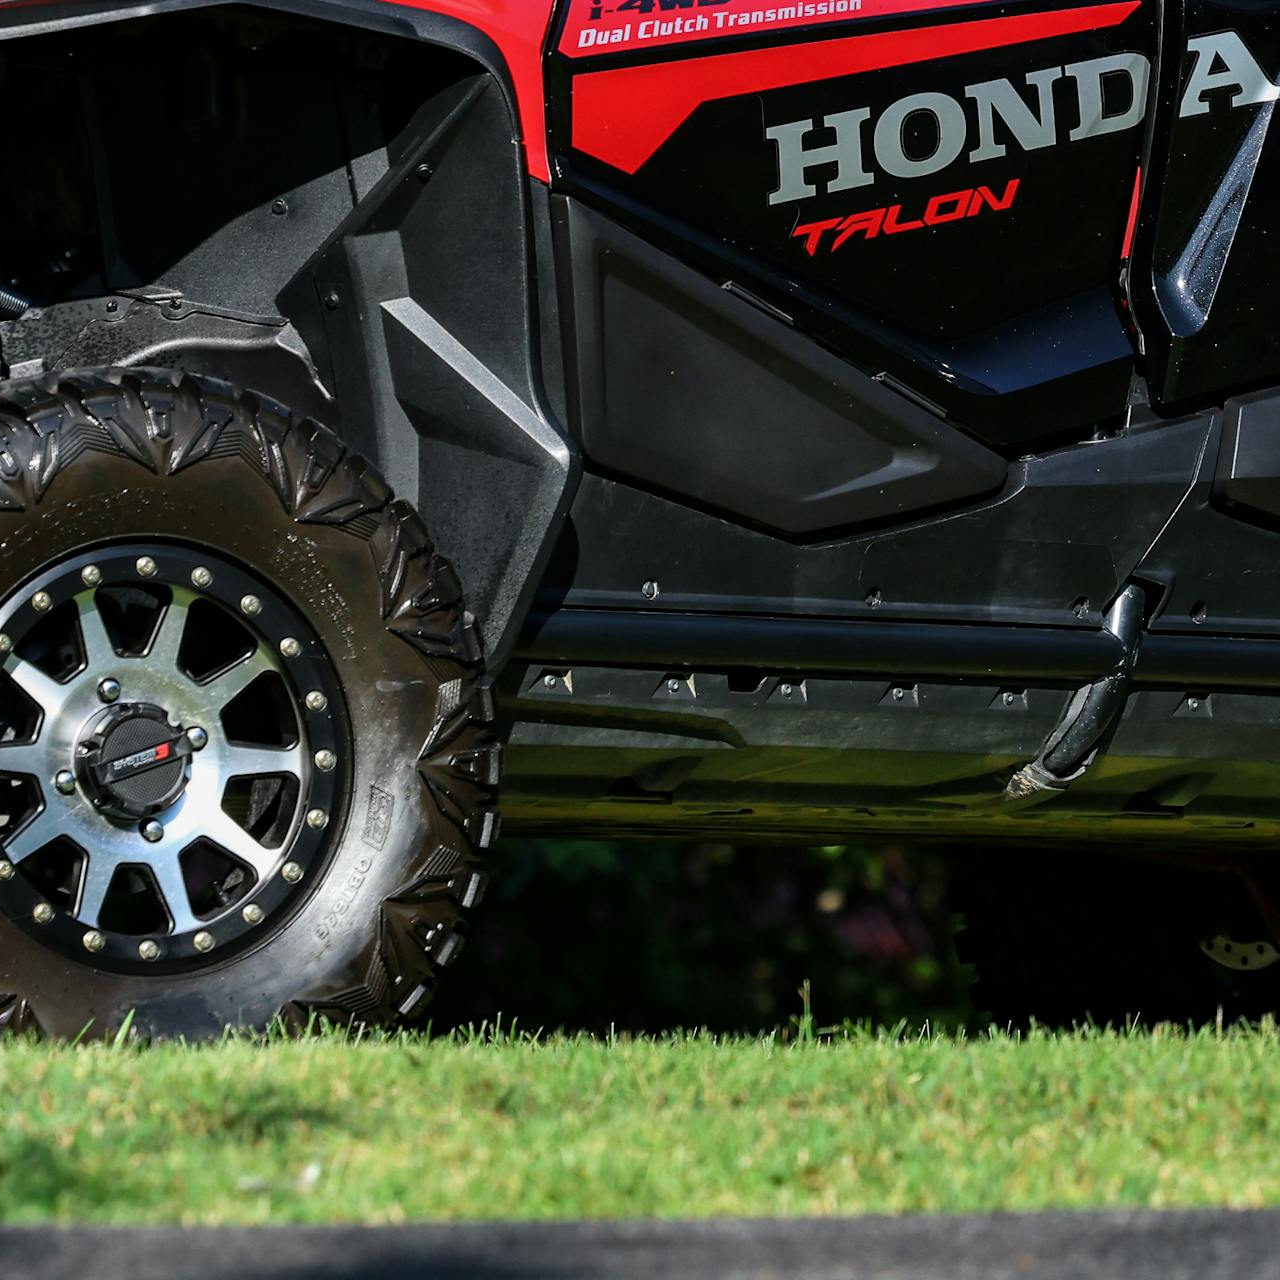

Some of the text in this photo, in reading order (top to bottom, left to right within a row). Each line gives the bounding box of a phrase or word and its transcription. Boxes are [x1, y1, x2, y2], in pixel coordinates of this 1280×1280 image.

[577, 23, 631, 49] Dual
[637, 14, 708, 39] Clutch
[792, 178, 1020, 257] TALON
